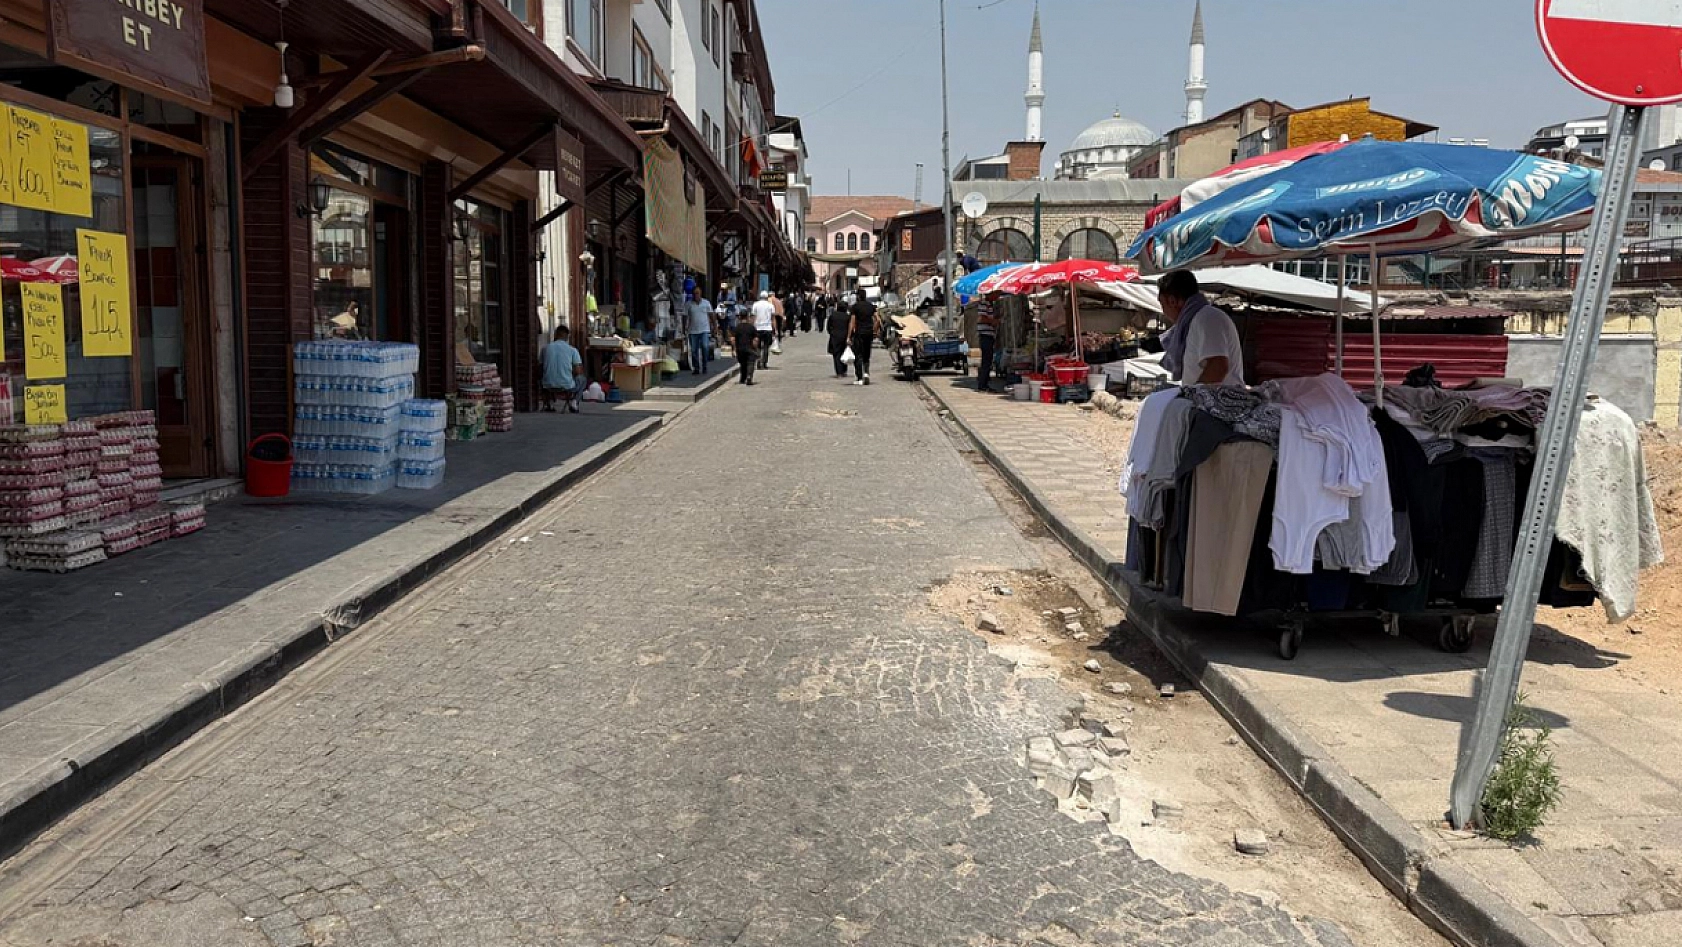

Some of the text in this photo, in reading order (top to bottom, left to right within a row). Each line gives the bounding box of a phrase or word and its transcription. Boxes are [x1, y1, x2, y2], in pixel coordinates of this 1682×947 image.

[122, 16, 152, 51] ET
[1297, 189, 1466, 244] Serin Lezzet!
